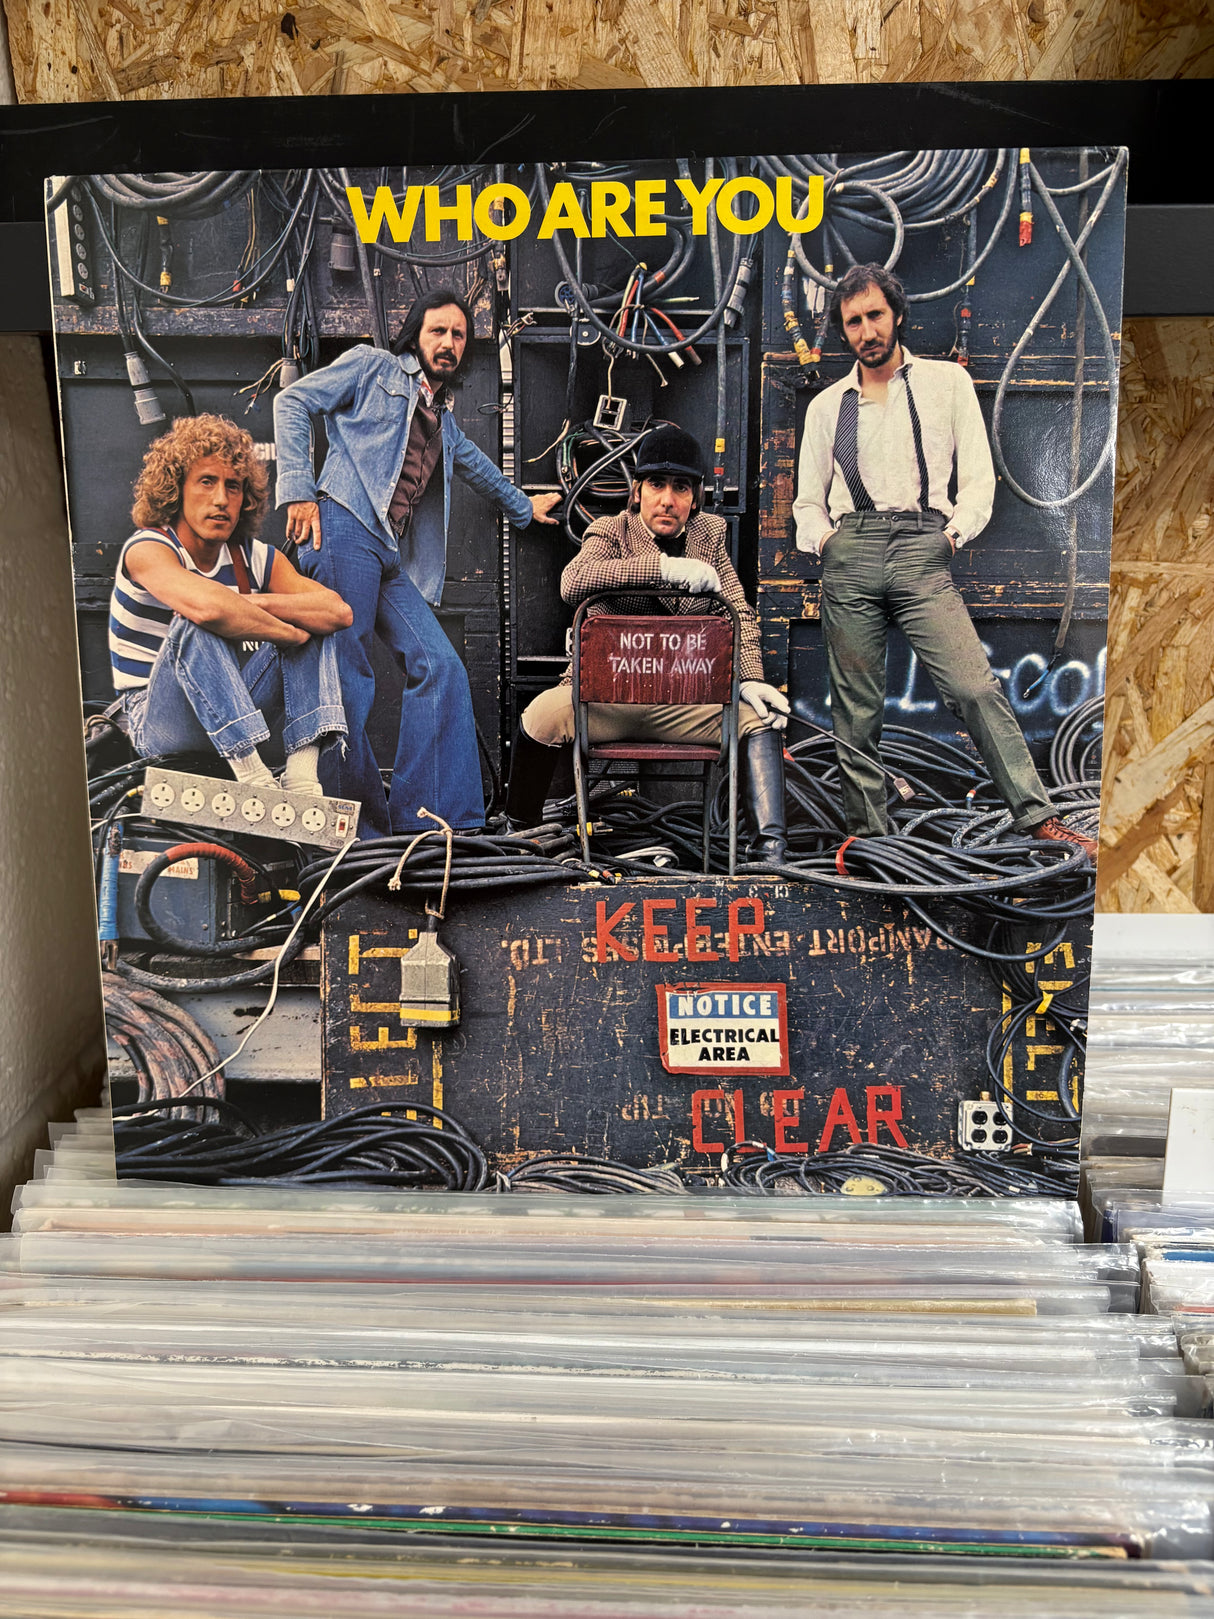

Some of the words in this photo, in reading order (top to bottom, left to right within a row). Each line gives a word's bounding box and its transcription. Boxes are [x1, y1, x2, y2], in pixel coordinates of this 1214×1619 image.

[345, 183, 532, 243] WHO
[537, 179, 667, 240] ARE
[675, 174, 825, 236] YOU
[620, 632, 654, 650] NOT
[660, 633, 681, 650] TO
[687, 633, 707, 650] BE
[609, 656, 664, 674] TAKEN
[670, 656, 716, 674] AWAY
[596, 897, 765, 963] KEEP
[678, 994, 772, 1016] NOTICE
[669, 1028, 780, 1046] ELECTRICAL
[698, 1047, 750, 1061] AREA
[692, 1086, 909, 1153] CLEAR
